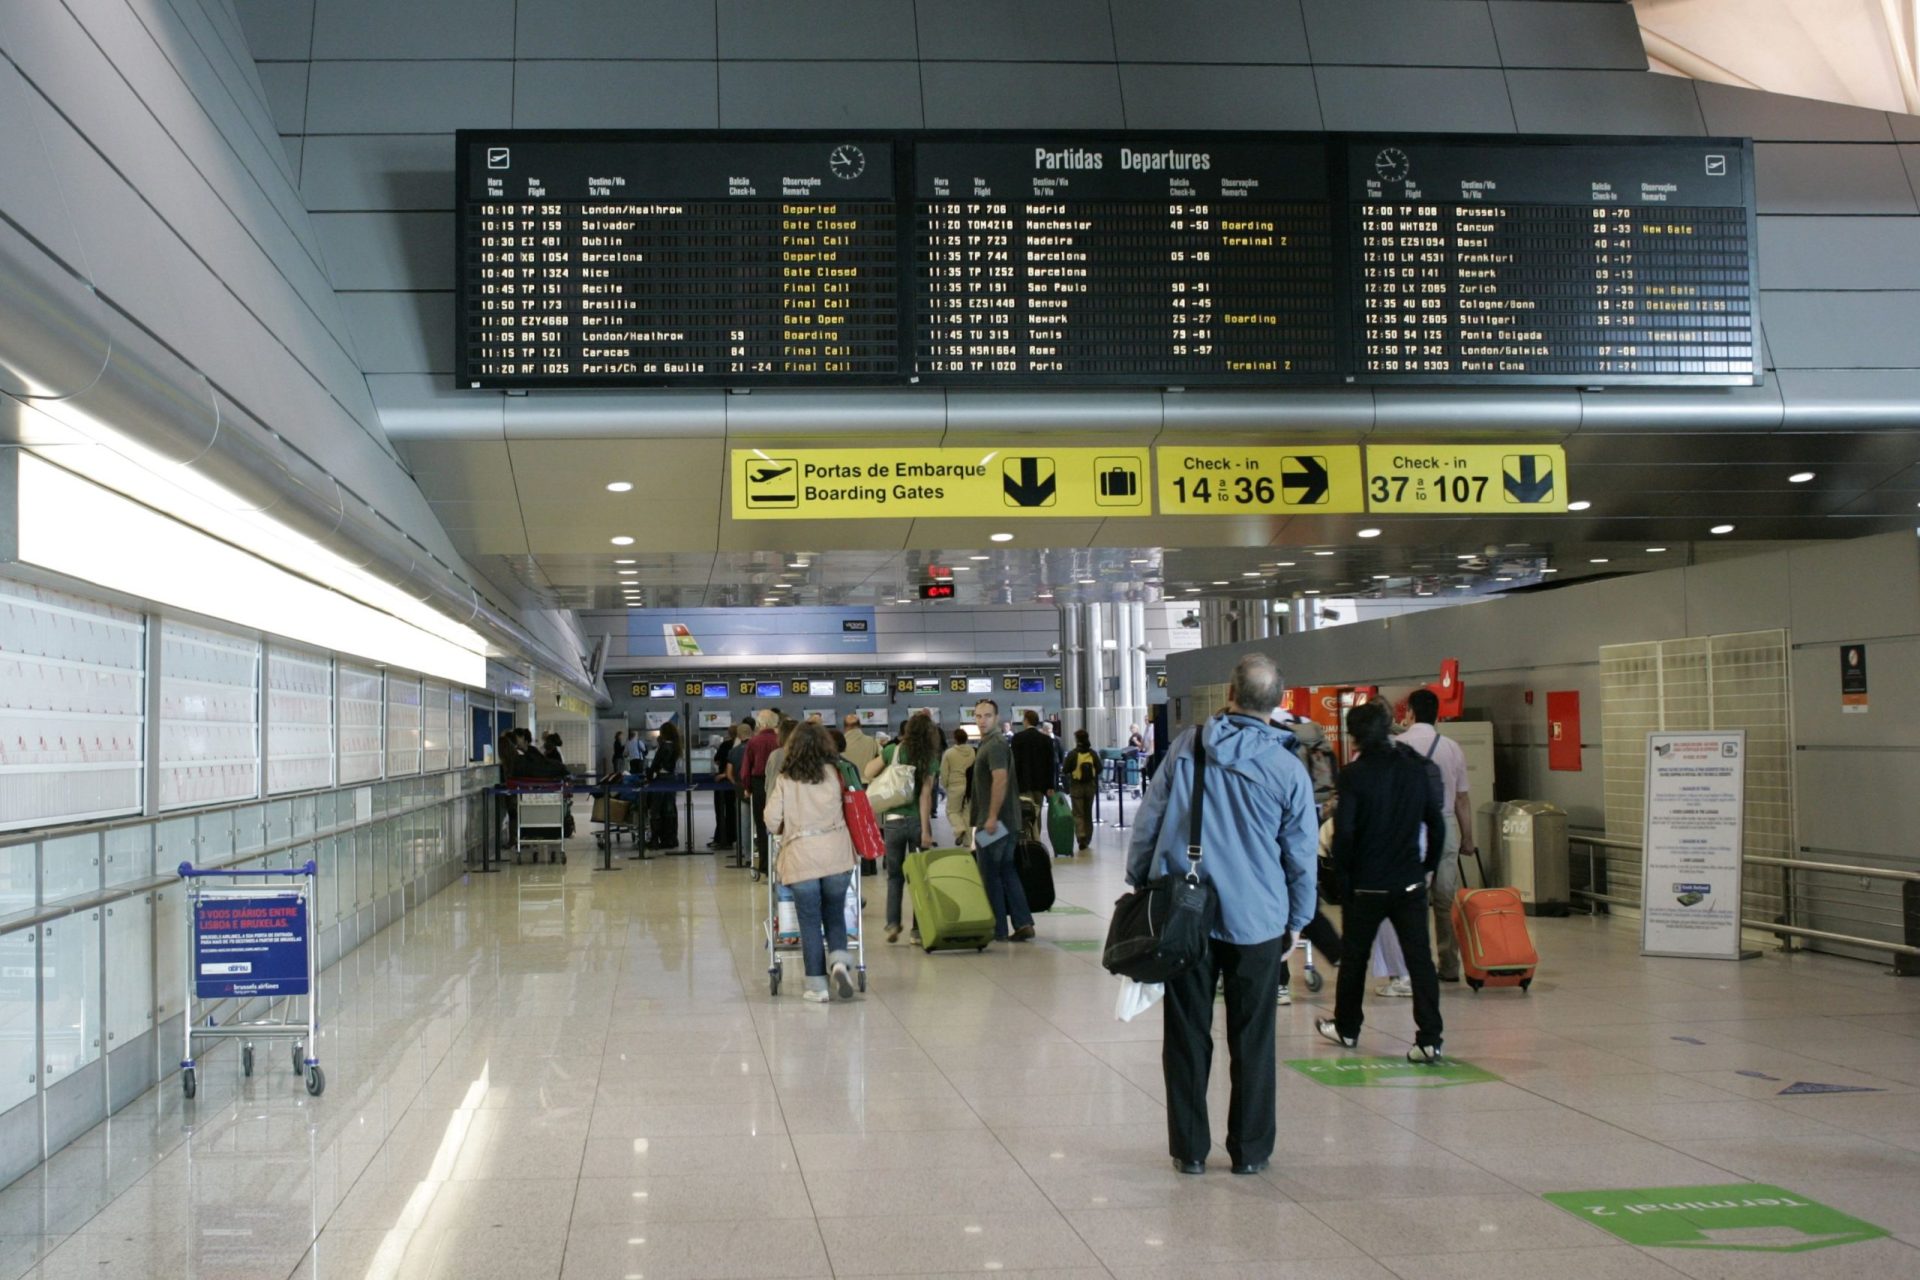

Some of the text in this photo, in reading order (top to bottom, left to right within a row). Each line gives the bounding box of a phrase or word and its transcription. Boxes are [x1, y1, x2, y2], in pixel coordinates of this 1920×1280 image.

[1035, 148, 1210, 173] Partidas Departures
[488, 177, 503, 187] Hora
[528, 177, 540, 187] Voo
[488, 188, 504, 196] Time
[528, 187, 546, 198] Flight
[782, 186, 810, 196] Remarks
[481, 204, 836, 215] 10:10 London/Heathrow Departed
[928, 204, 1066, 214] 11:20 Madrid
[1362, 206, 1506, 217] 12:00 Brussels
[482, 220, 857, 231] 10:15 Salvador Gate Closed
[928, 220, 1274, 232] 11:20 Manchester Boarding
[1362, 221, 1692, 234] 12:00 Cancun New Gate
[482, 236, 849, 247] 10:30 Dublin Final Call
[929, 235, 1287, 246] 11:25 Madeira Terminal 2
[1363, 236, 1487, 247] 12:05 Basel
[481, 251, 837, 263] 10:40 Barcelona Departed
[929, 251, 1087, 261] 11:35 Barcelona
[1364, 252, 1513, 263] 12:10 Frankfurt
[481, 267, 857, 279] 10:40 Nice Gate Closed
[929, 267, 1087, 277] 11:35 Barcelona
[1364, 267, 1496, 278] 12:15 Newark
[482, 283, 849, 294] 10:45 Recife Final Call
[929, 282, 1087, 292] 11:35 Sao Paulo
[1365, 283, 1497, 294] 12:20 Zurich
[482, 298, 849, 310] 10:50 Brasilia Final Call
[930, 298, 1068, 308] 11:35 Geneva
[1365, 298, 1535, 310] 12:35 Cologne/Bonn
[482, 314, 844, 326] 11:00 Berlin Gate Open
[930, 314, 1277, 325] 11:45 Newark Boarding
[1366, 314, 1516, 326] 12:35 Stuttgart
[482, 330, 838, 342] 11:05 London/Heathrow Boarding
[930, 329, 1062, 340] 11:45 Tunis
[1366, 329, 1543, 341] 12:50 Ponta Delgada
[482, 346, 850, 358] 11:15 Caracas Final Call
[930, 345, 1056, 356] 11:55 Rome
[1367, 345, 1549, 356] 12:50 London/Gatwick
[482, 361, 850, 374] 11:20 Paris/Ch de Gaulle Final Call
[931, 360, 1291, 371] 12:00 Porto Terminal 2
[1367, 360, 1525, 371] 12:50 Punta Cana
[1184, 456, 1231, 470] Check
[1246, 457, 1259, 470] in
[1392, 456, 1440, 469] Check
[1454, 456, 1467, 468] in
[804, 462, 987, 480] Portas de Embarque
[804, 484, 944, 504] Boarding Gates
[1172, 476, 1275, 504] 14 a to 36
[1370, 475, 1489, 503] 37 a to 107
[685, 684, 701, 695] 88
[740, 682, 755, 694] 87
[792, 682, 808, 693] 86
[846, 681, 861, 692] 85
[898, 680, 914, 692] 84
[950, 680, 966, 691] 83
[1004, 678, 1019, 690] 82
[632, 685, 648, 696] 89
[208, 910, 230, 919] VOOS
[233, 906, 268, 918] DIÁRIOS
[270, 908, 298, 917] ENTRE
[200, 920, 231, 930] LISBOA
[233, 920, 239, 929] E
[258, 982, 279, 990] airlines
[1583, 1197, 1809, 1216] Terminal 2
